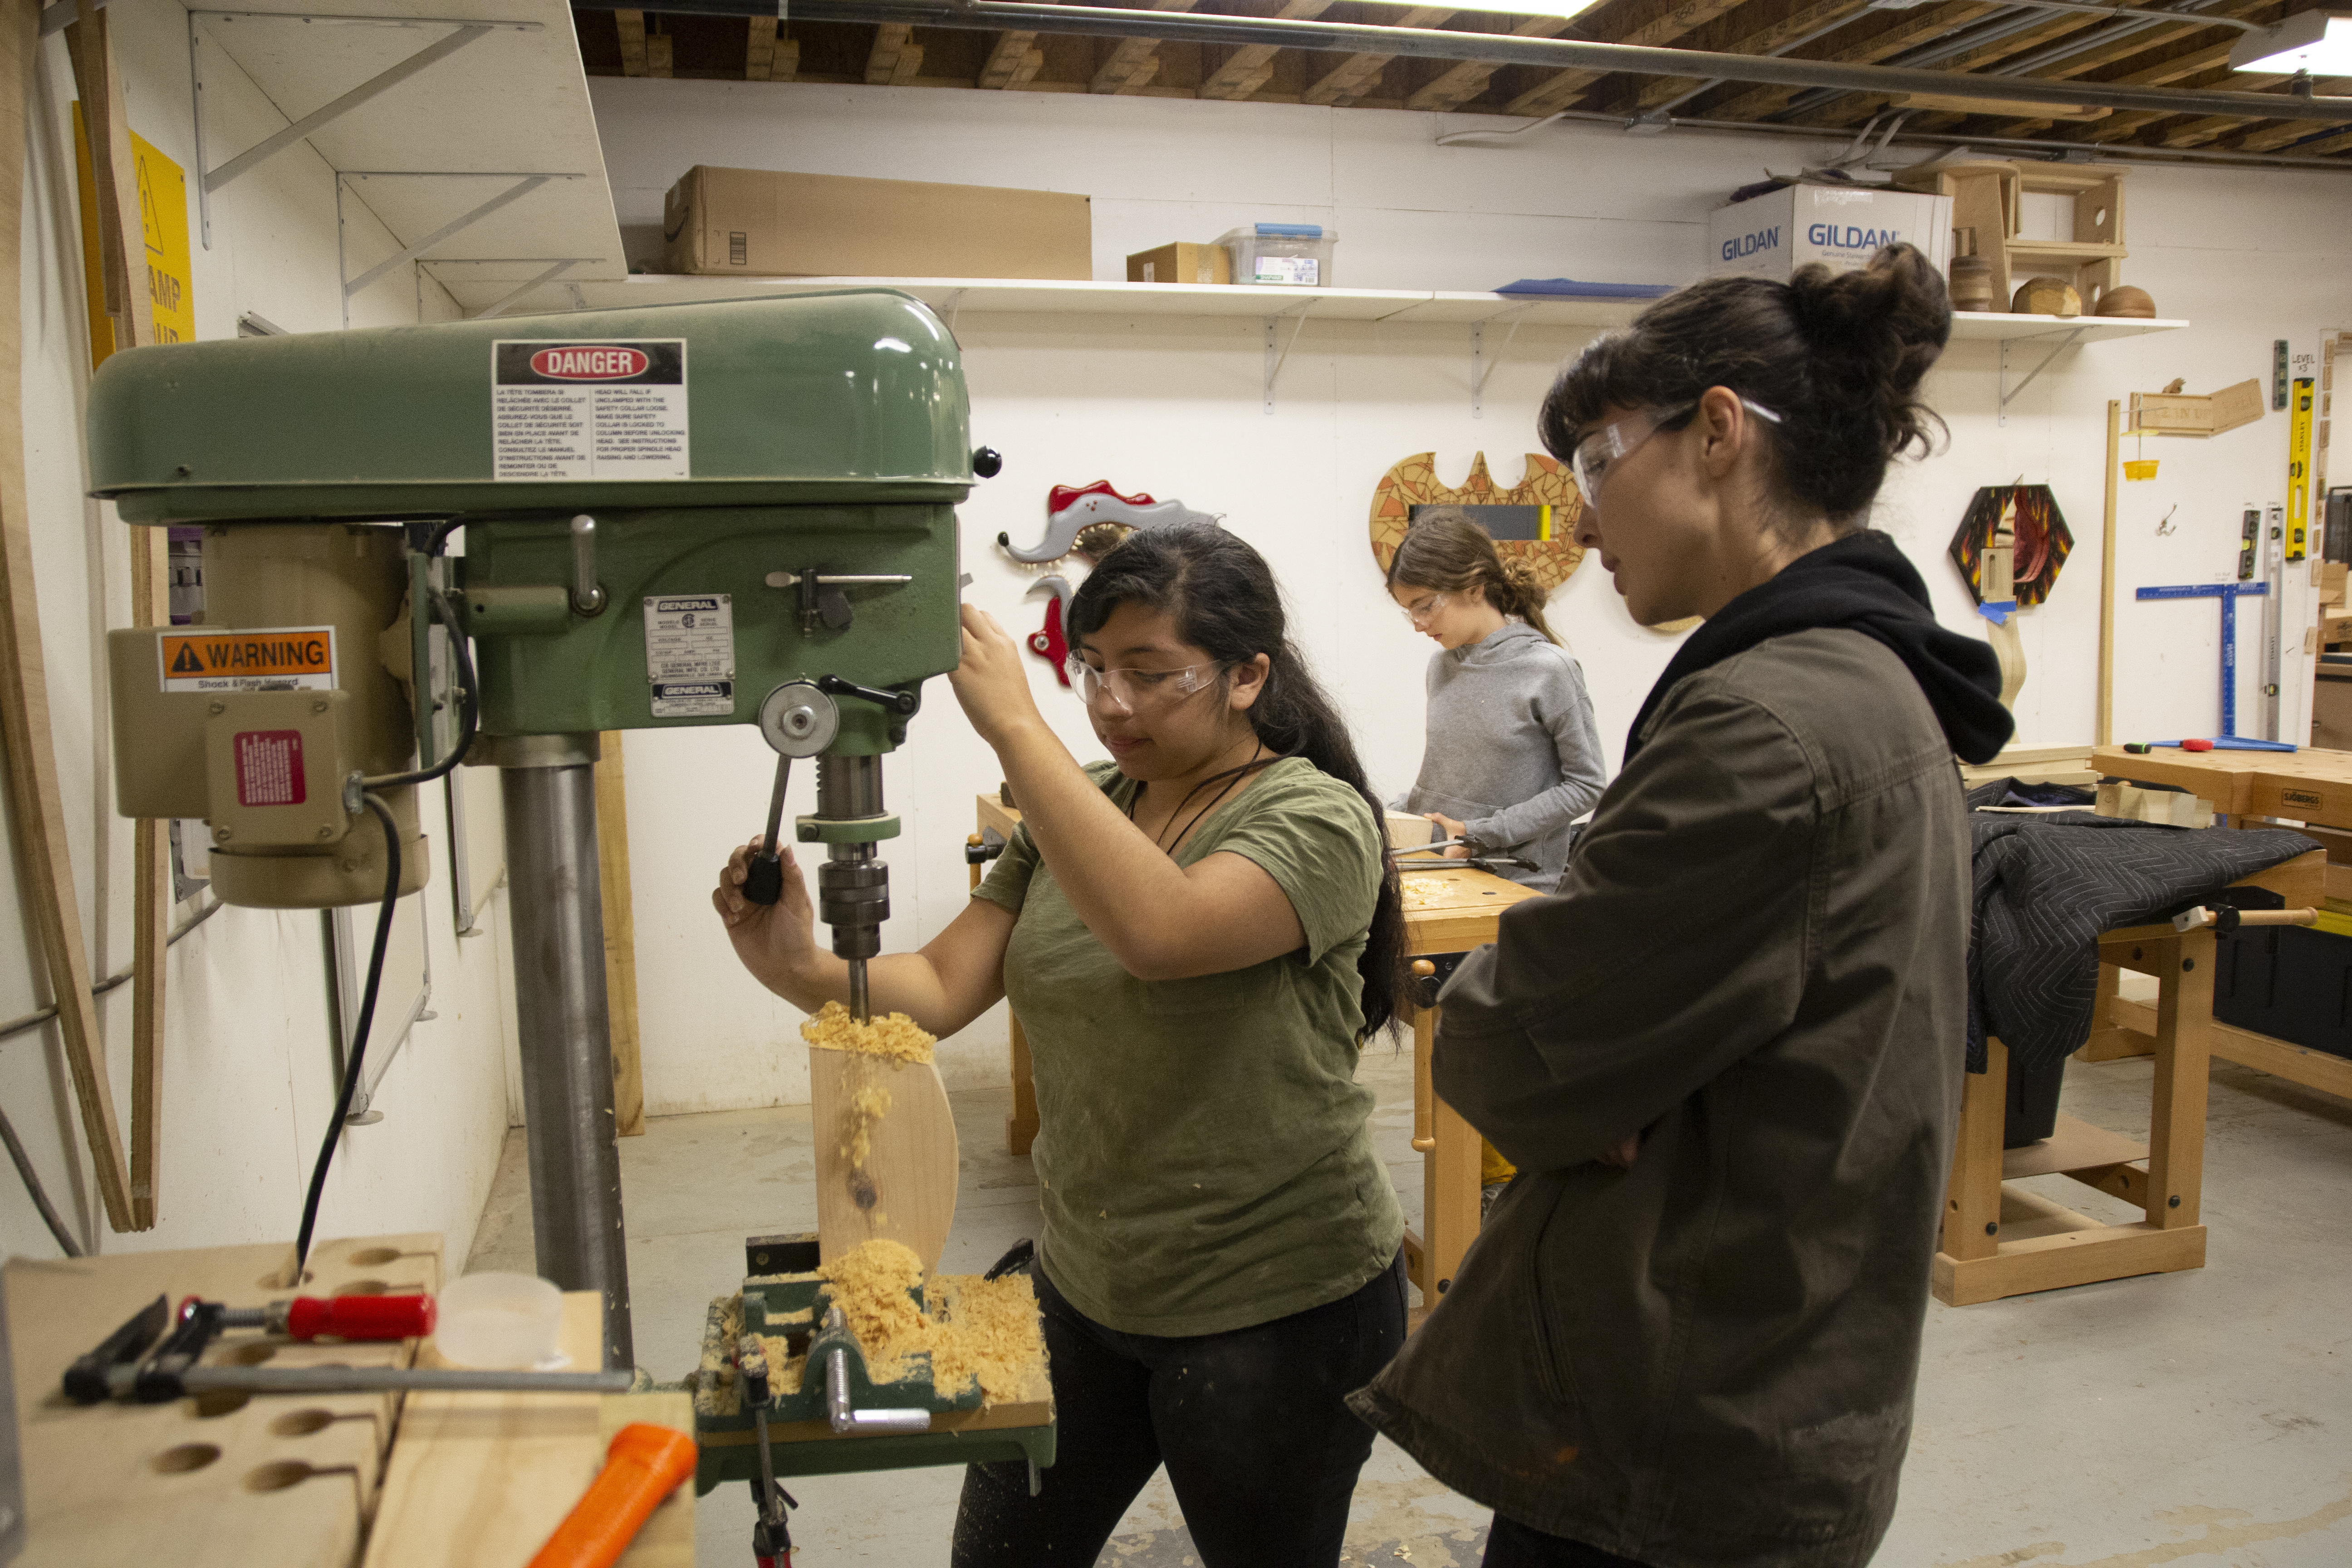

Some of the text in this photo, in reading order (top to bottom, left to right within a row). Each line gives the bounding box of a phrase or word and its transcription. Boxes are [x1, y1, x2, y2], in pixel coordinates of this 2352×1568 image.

[1673, 2, 1696, 23] 360
[1722, 226, 1779, 261] GILDAN
[1808, 224, 1897, 250] GILDAN
[548, 352, 633, 374] DANGER
[2292, 354, 2315, 364] LEVEL
[660, 601, 716, 610] GENERAL
[206, 641, 324, 668] WARNING
[198, 680, 228, 688] Shock
[233, 679, 238, 687] &
[240, 678, 261, 687] Flash
[665, 686, 718, 695] GENERAL
[2284, 791, 2319, 804] SJÖBERGS
